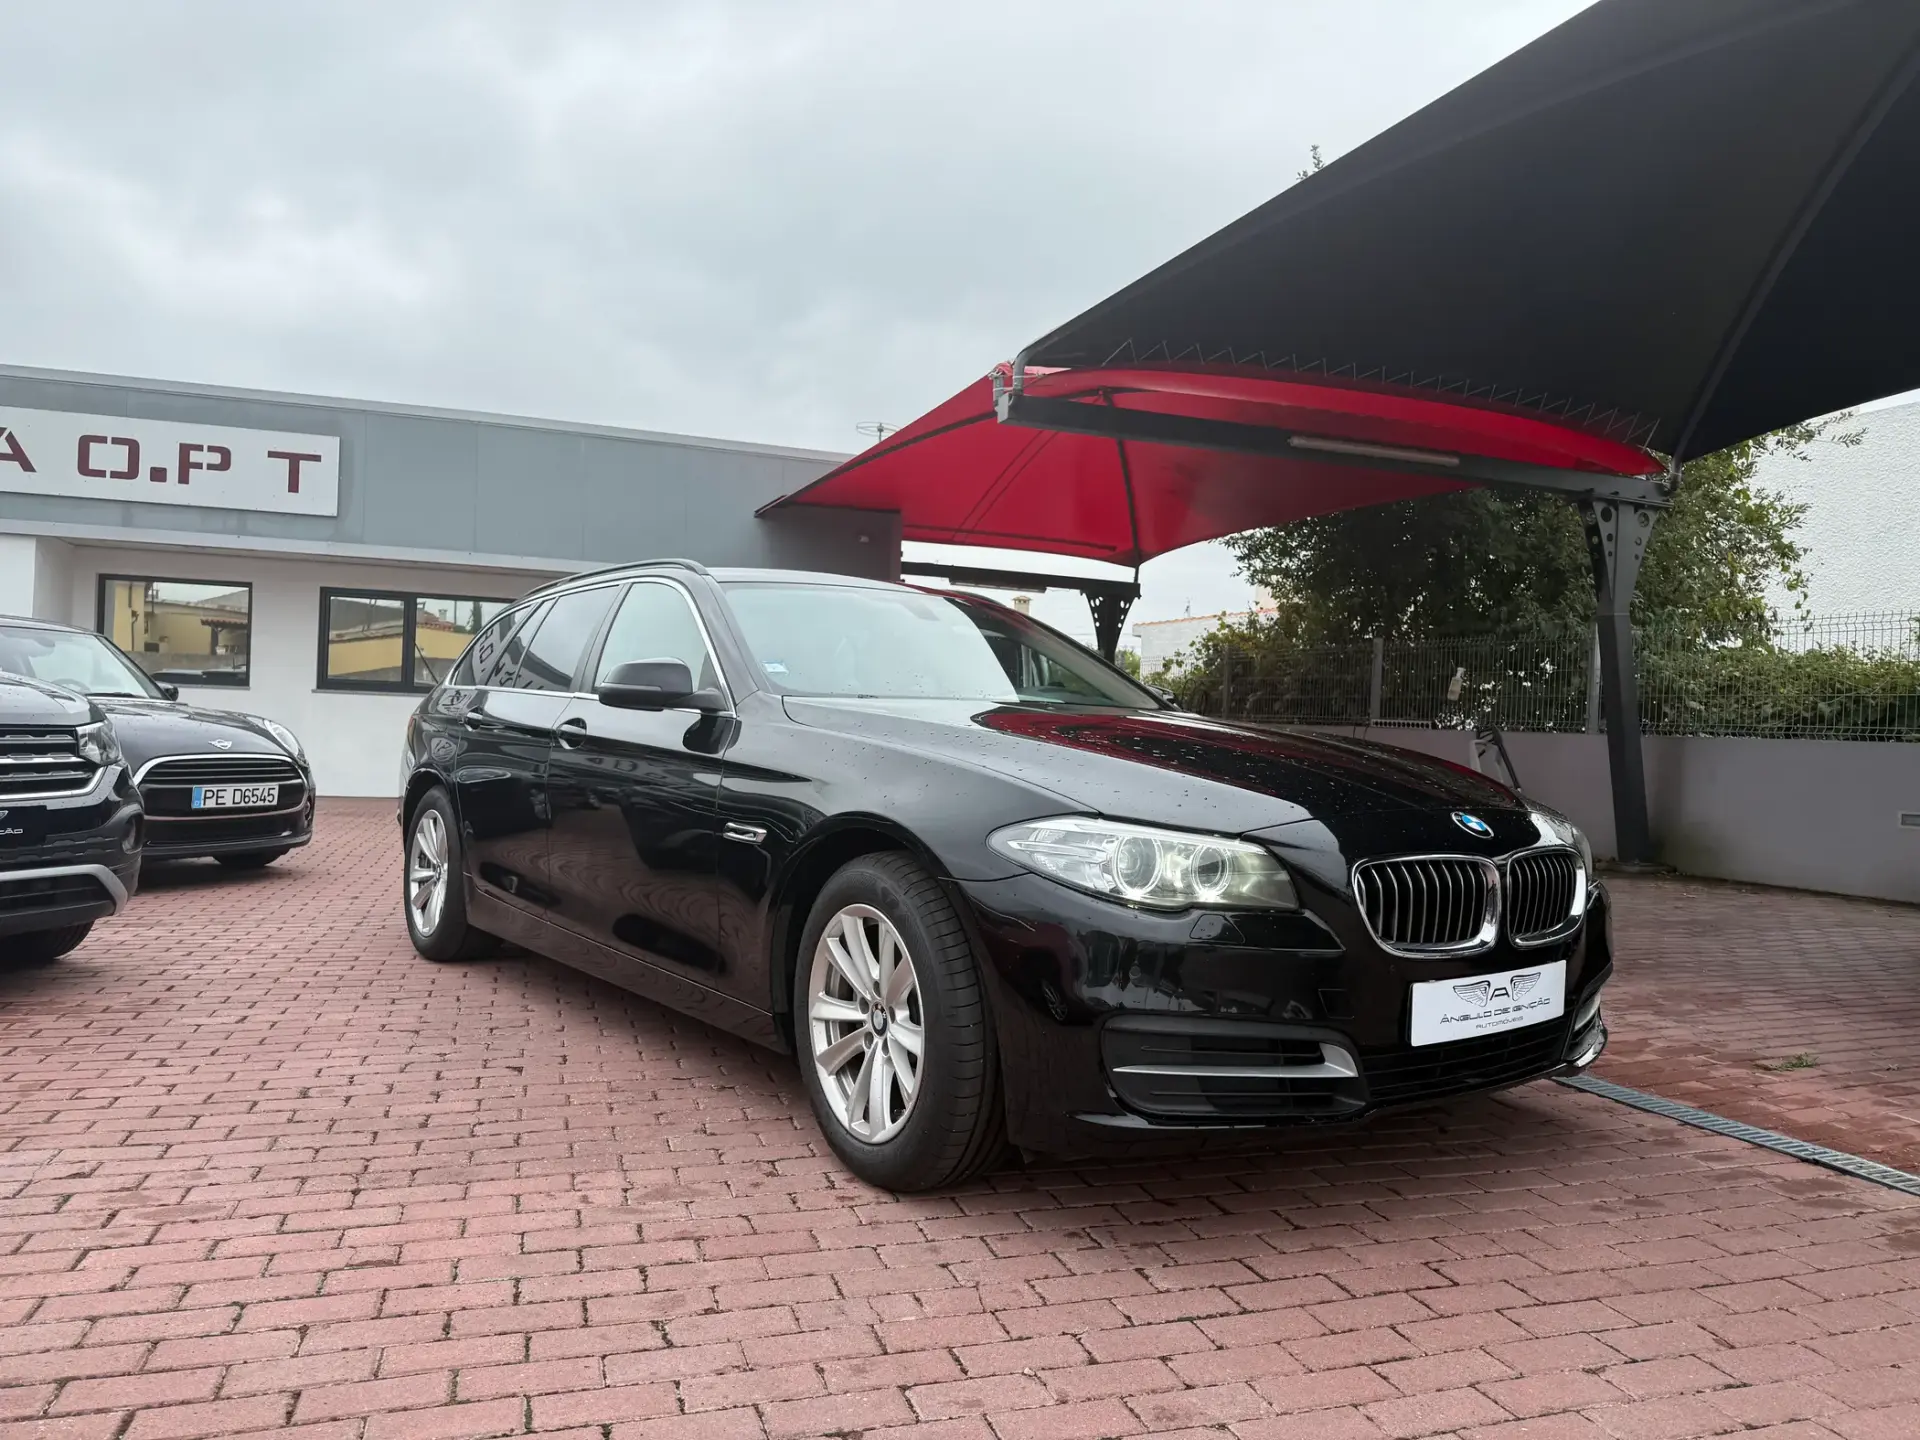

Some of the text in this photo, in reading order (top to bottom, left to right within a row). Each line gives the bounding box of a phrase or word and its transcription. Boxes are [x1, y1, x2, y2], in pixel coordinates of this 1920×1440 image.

[203, 787, 276, 806] PE D6545
[1494, 1007, 1510, 1016] DE
